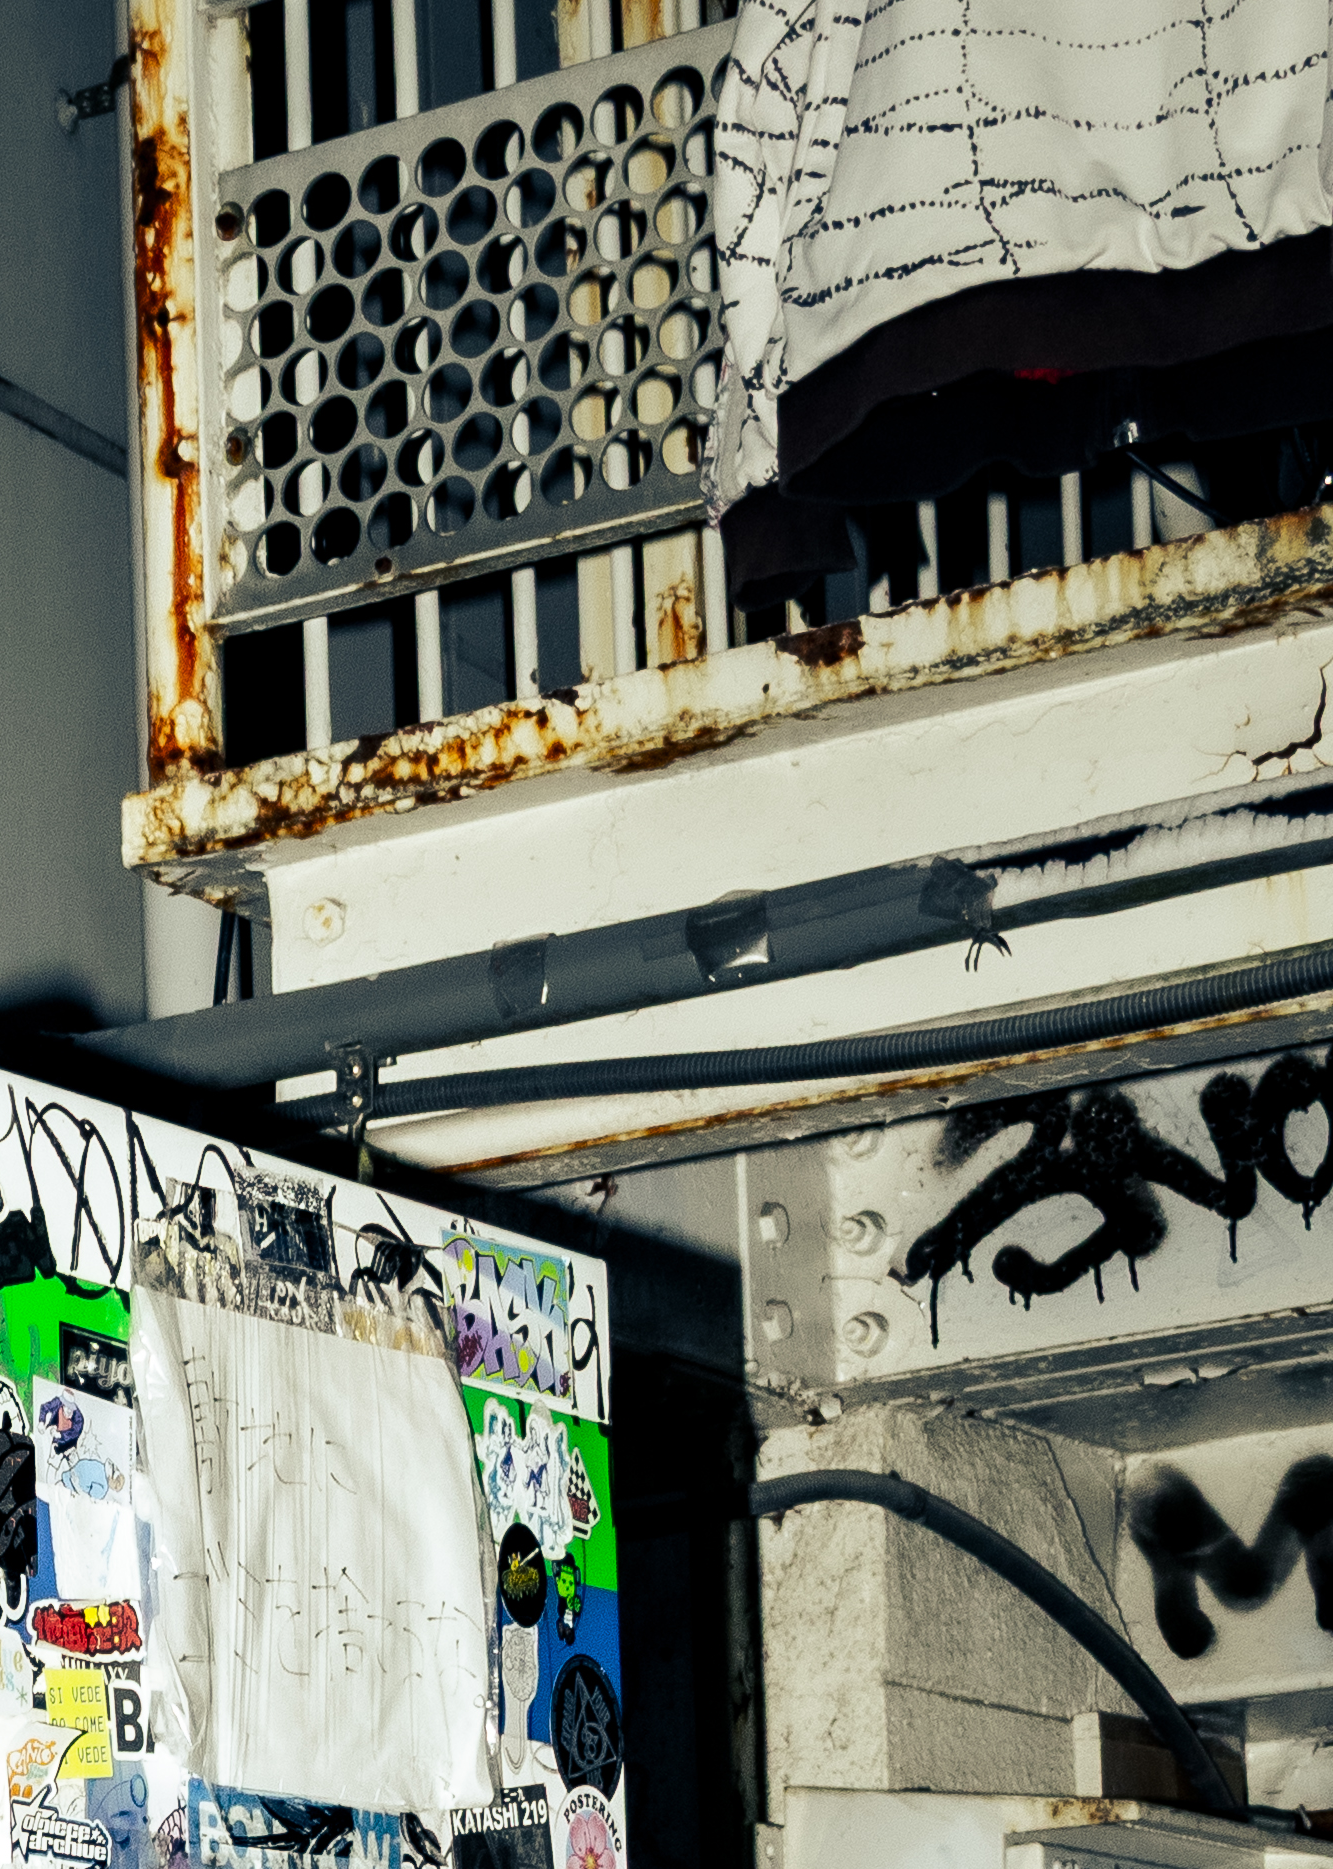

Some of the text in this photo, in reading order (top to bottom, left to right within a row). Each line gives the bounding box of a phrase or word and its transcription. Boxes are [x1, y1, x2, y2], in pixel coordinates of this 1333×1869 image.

[49, 1686, 101, 1704] SI VEDE
[75, 1716, 104, 1732] COME
[77, 1746, 108, 1764] VEDE
[452, 1799, 547, 1835] KATASHI 219
[564, 1793, 622, 1852] POSTERING
